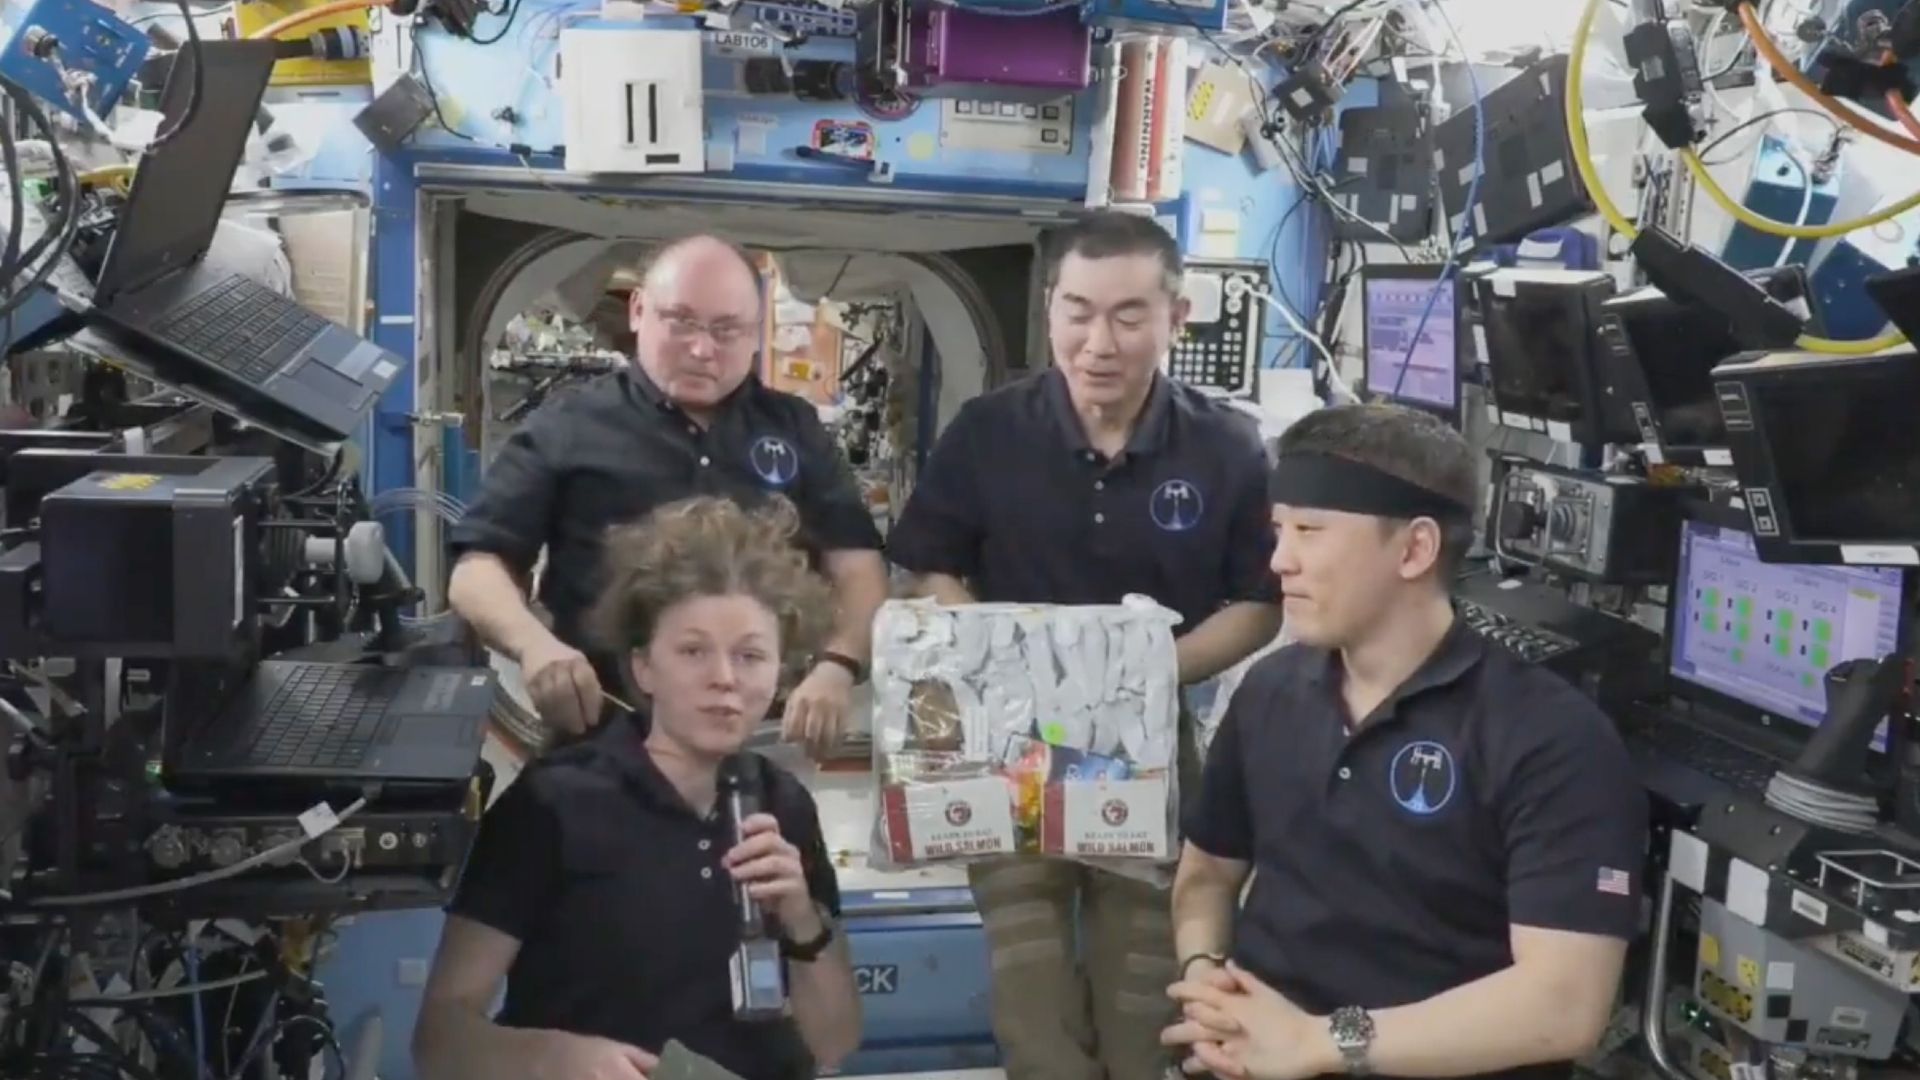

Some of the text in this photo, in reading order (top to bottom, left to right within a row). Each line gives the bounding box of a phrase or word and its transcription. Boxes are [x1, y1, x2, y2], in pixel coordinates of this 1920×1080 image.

[1139, 79, 1152, 169] WARNING
[925, 836, 1002, 856] WILD SALMON
[1077, 840, 1155, 853] WILD SALMON
